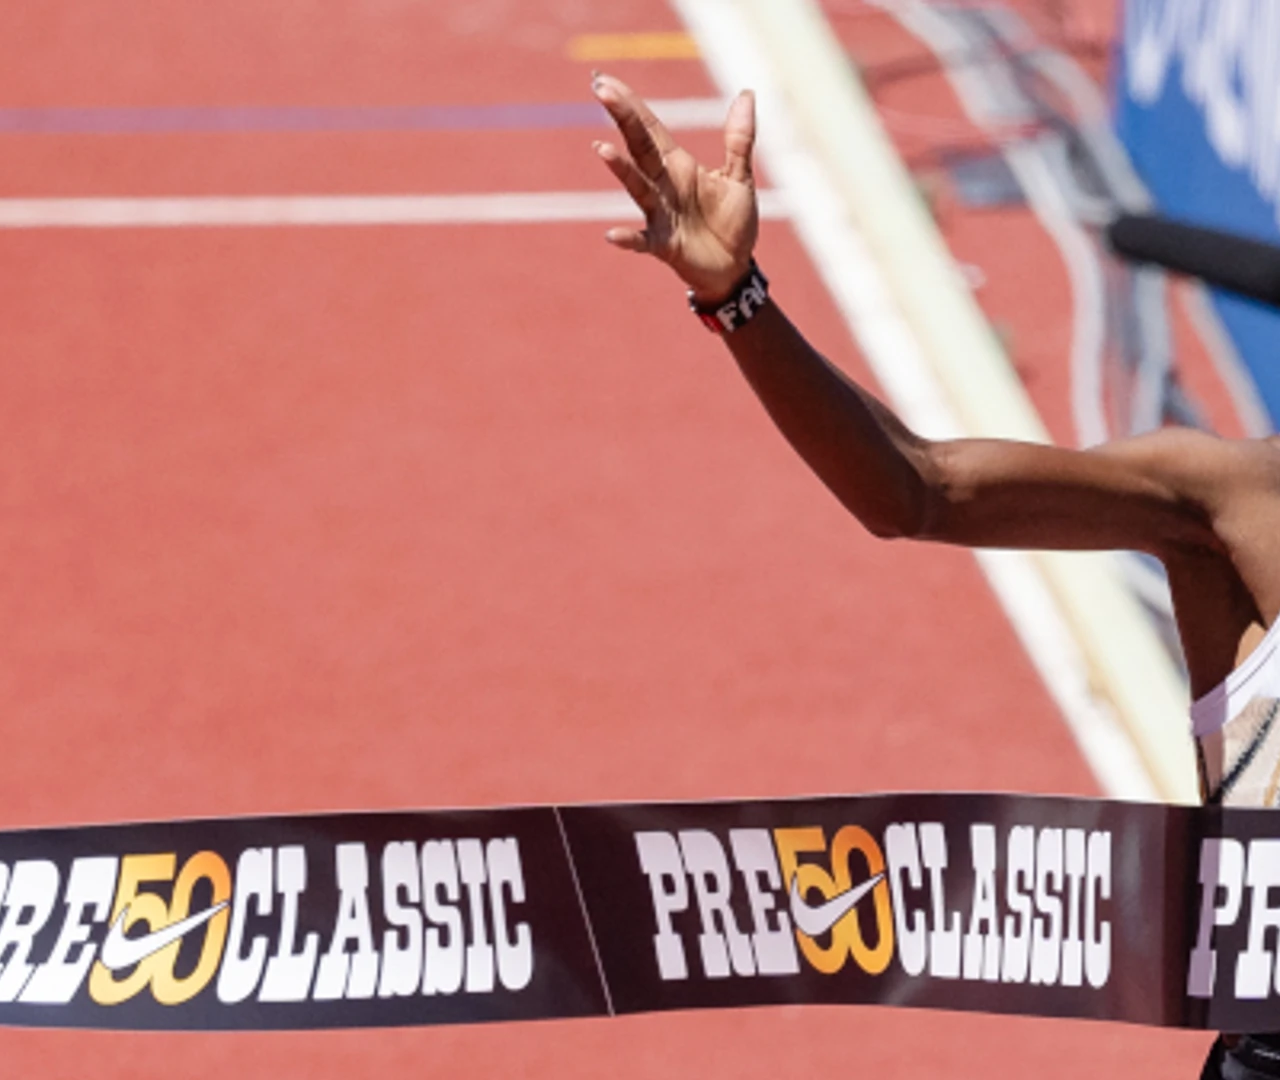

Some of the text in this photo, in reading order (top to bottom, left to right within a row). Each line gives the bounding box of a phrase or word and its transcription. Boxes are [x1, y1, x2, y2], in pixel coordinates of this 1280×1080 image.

[218, 838, 532, 1004] CLASSIC
[634, 830, 800, 981] PRE
[884, 821, 1112, 989] CLASSIC
